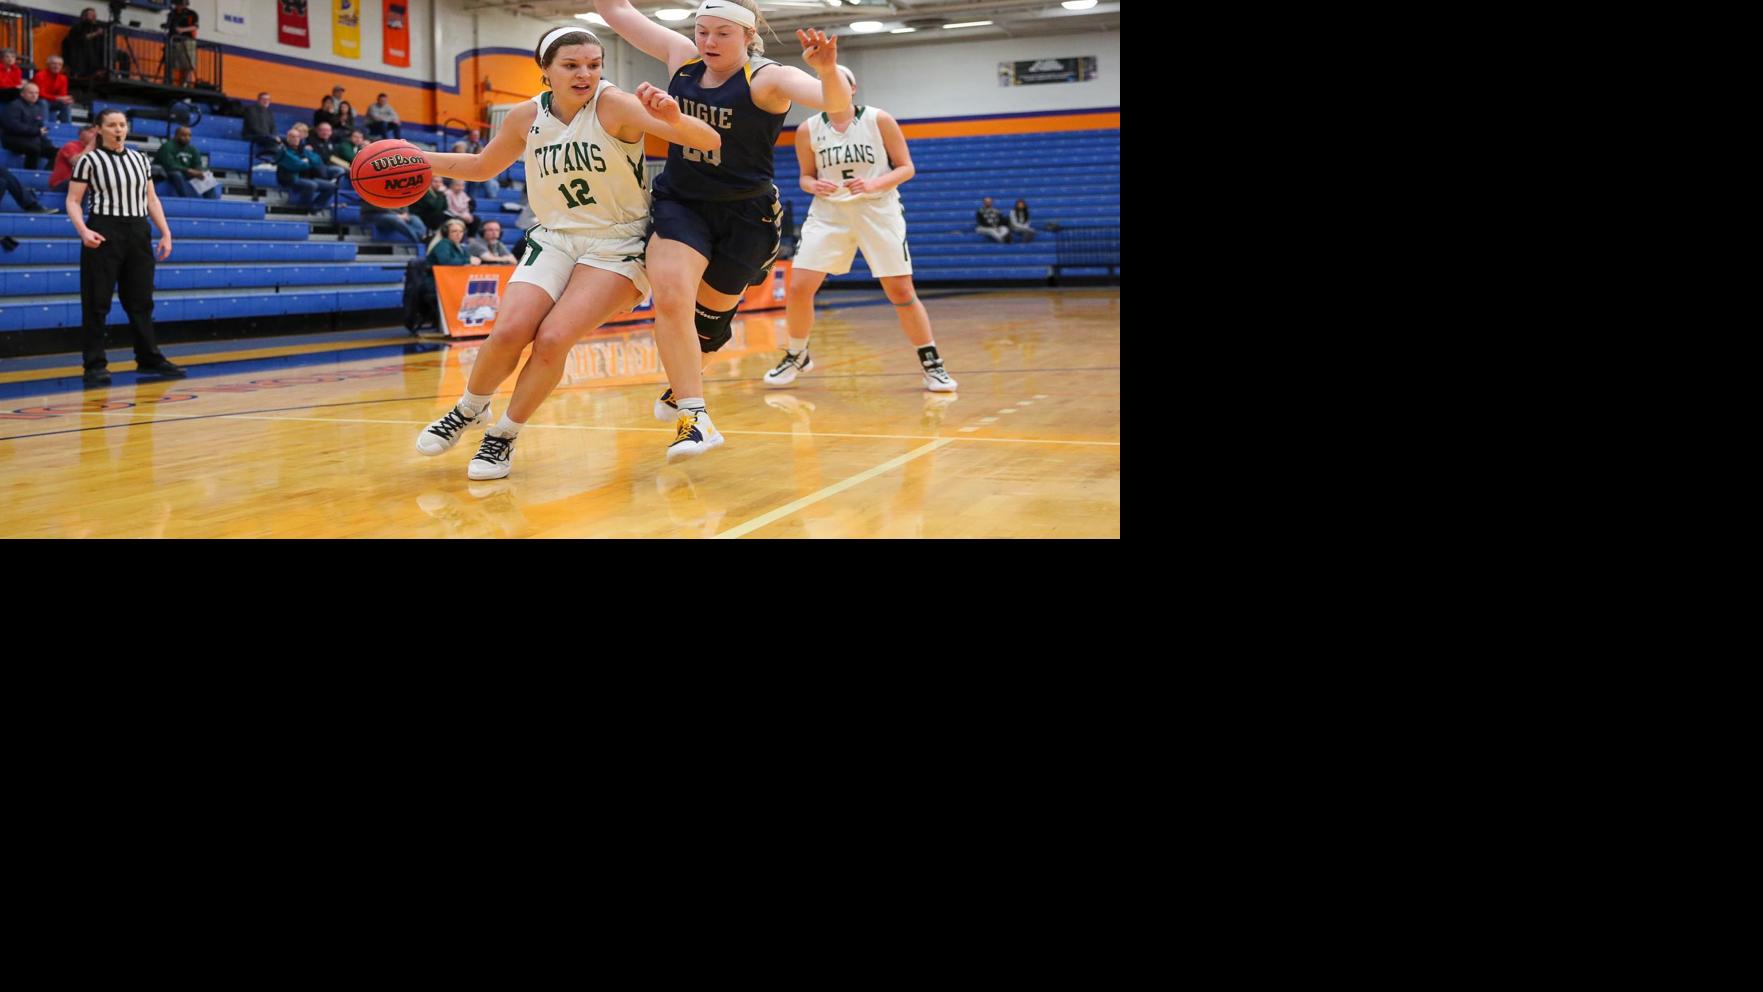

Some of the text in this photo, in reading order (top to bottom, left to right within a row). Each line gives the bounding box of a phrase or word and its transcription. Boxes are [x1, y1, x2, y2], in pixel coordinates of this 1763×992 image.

[370, 154, 425, 172] Wilson
[534, 141, 607, 178] TITANS
[818, 143, 875, 168] TITANS
[384, 174, 425, 190] NCAA
[558, 178, 597, 209] 12
